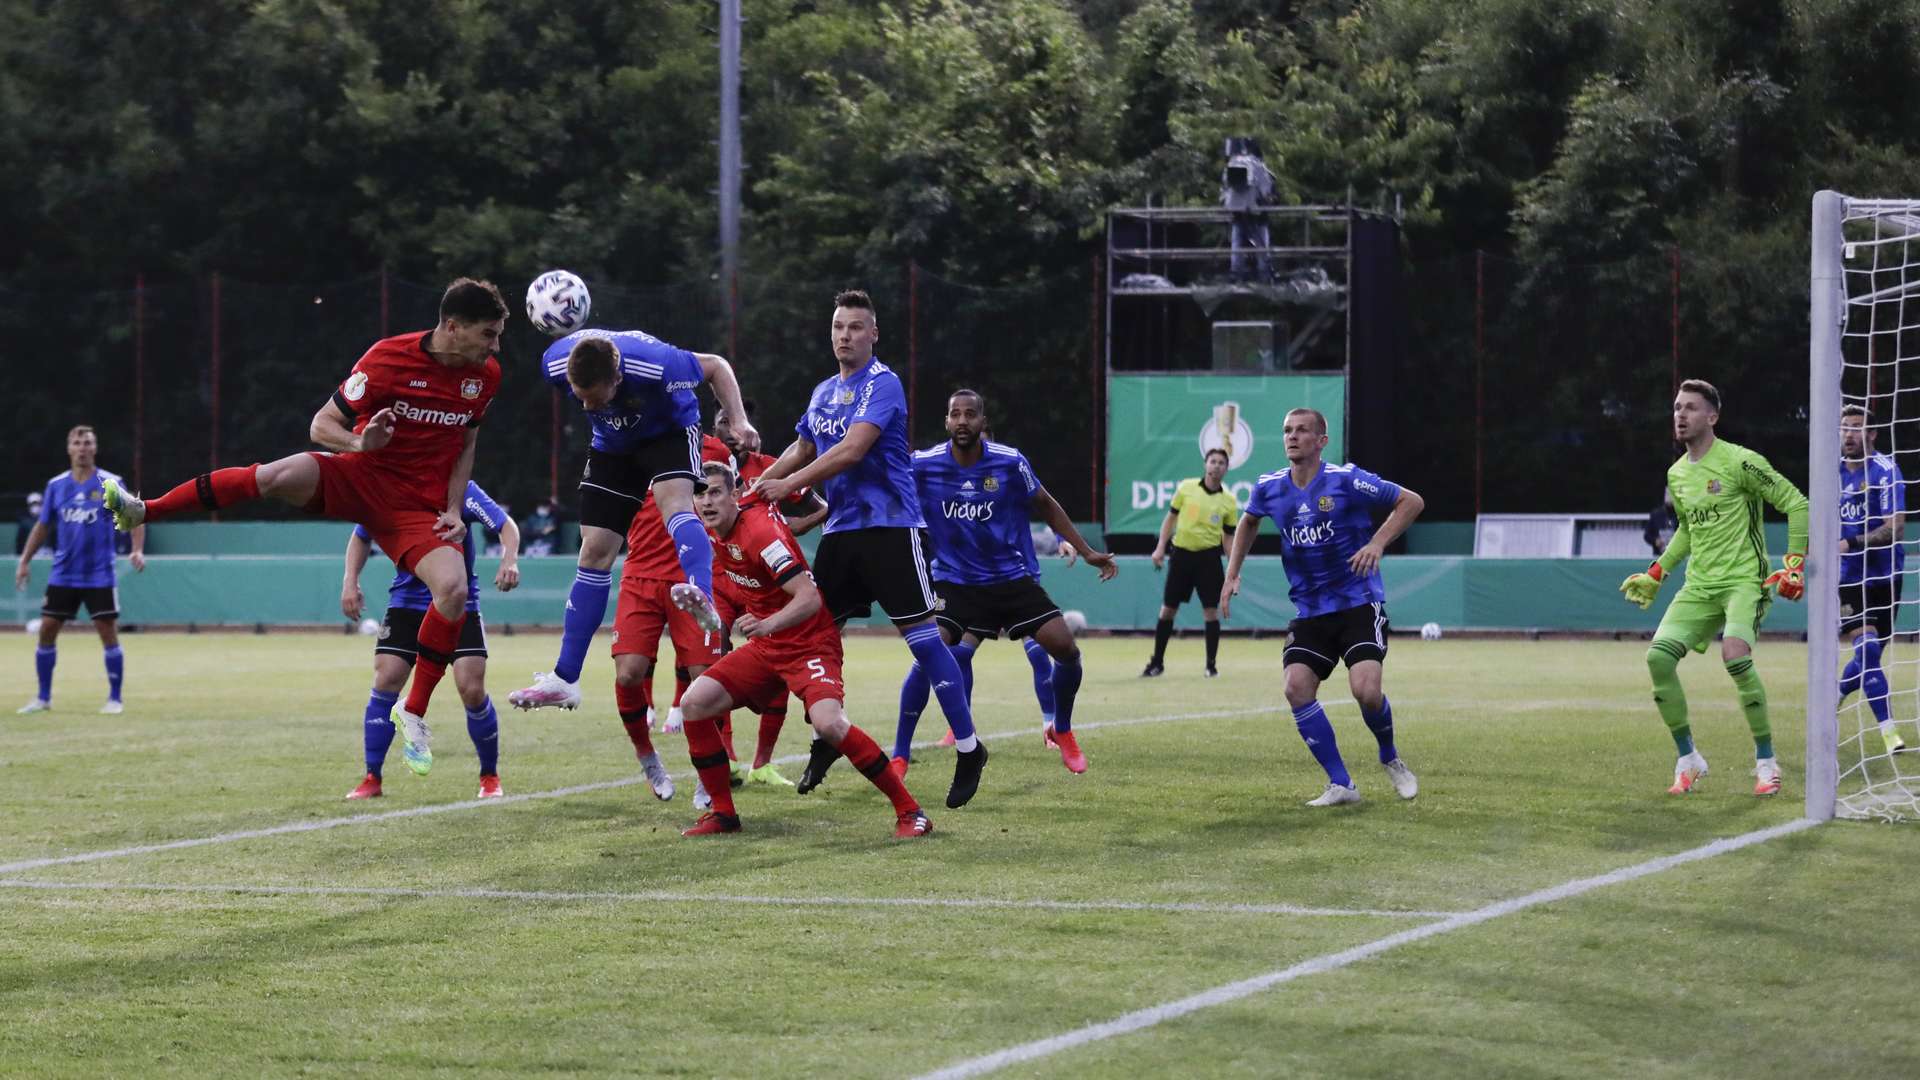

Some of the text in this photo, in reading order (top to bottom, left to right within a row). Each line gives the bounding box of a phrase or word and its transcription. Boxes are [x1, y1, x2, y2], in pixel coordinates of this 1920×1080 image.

[409, 380, 428, 388] JAKO
[393, 400, 473, 426] Barmeni
[942, 500, 994, 522] Victor's
[1283, 520, 1335, 546] Victor's
[806, 657, 826, 680] 5
